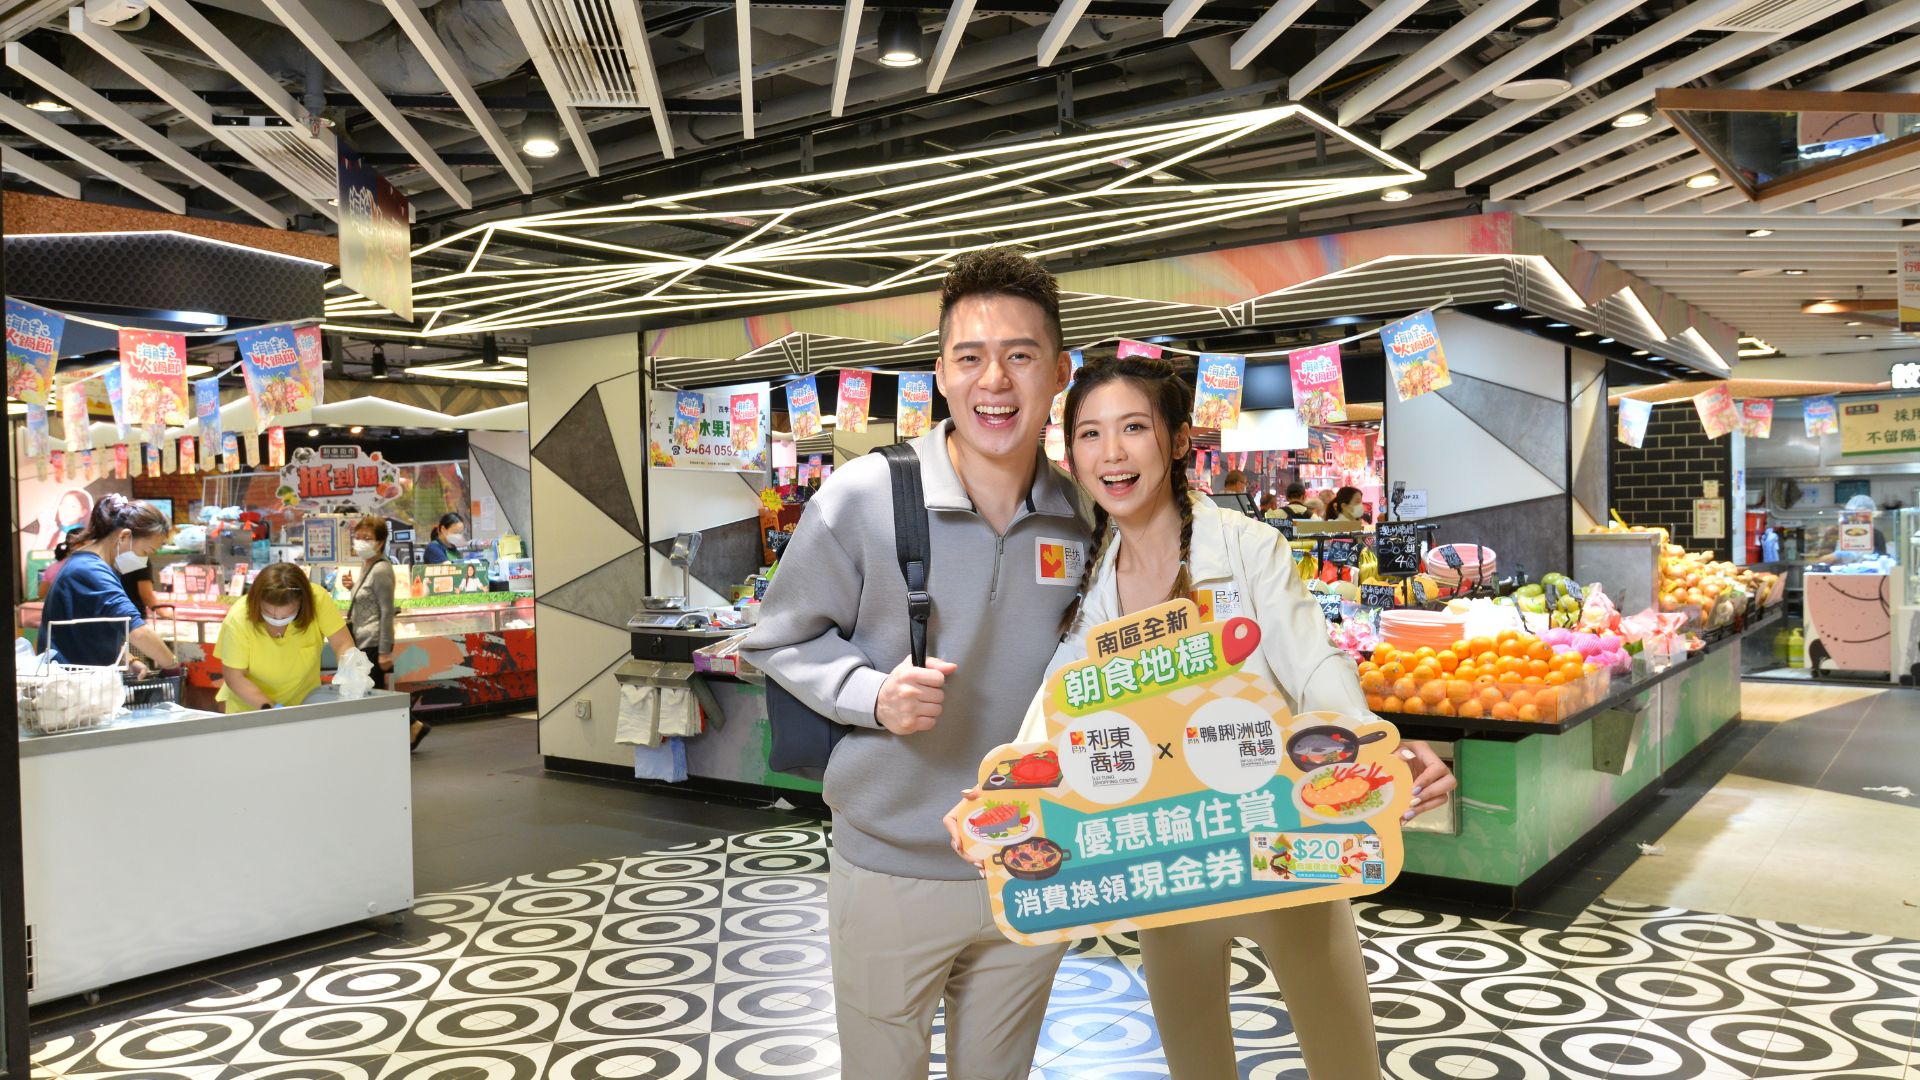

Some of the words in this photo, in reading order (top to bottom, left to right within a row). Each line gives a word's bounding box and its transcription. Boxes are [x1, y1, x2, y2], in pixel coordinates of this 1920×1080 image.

[137, 343, 168, 360] 海鮮
[1391, 332, 1436, 358] 火鍋節
[130, 355, 182, 375] 火鍋節
[249, 348, 297, 368] 火鍋節
[1302, 355, 1327, 373] 海鮮
[1208, 364, 1231, 377] 海鮮
[1297, 366, 1338, 385] 火鍋節
[1202, 372, 1239, 390] 火鍋節
[714, 445, 739, 457] 0592
[1215, 590, 1240, 603] 民坊
[1096, 606, 1189, 658] 南區全新
[1063, 632, 1214, 707] 朝食地標
[1087, 727, 1133, 750] 利東
[1200, 720, 1273, 743] 鴨脷洲邨
[1238, 739, 1276, 757] 商場
[1090, 750, 1136, 774] 商場
[1075, 790, 1278, 860] 優惠輪住賞
[1293, 838, 1340, 860] $20
